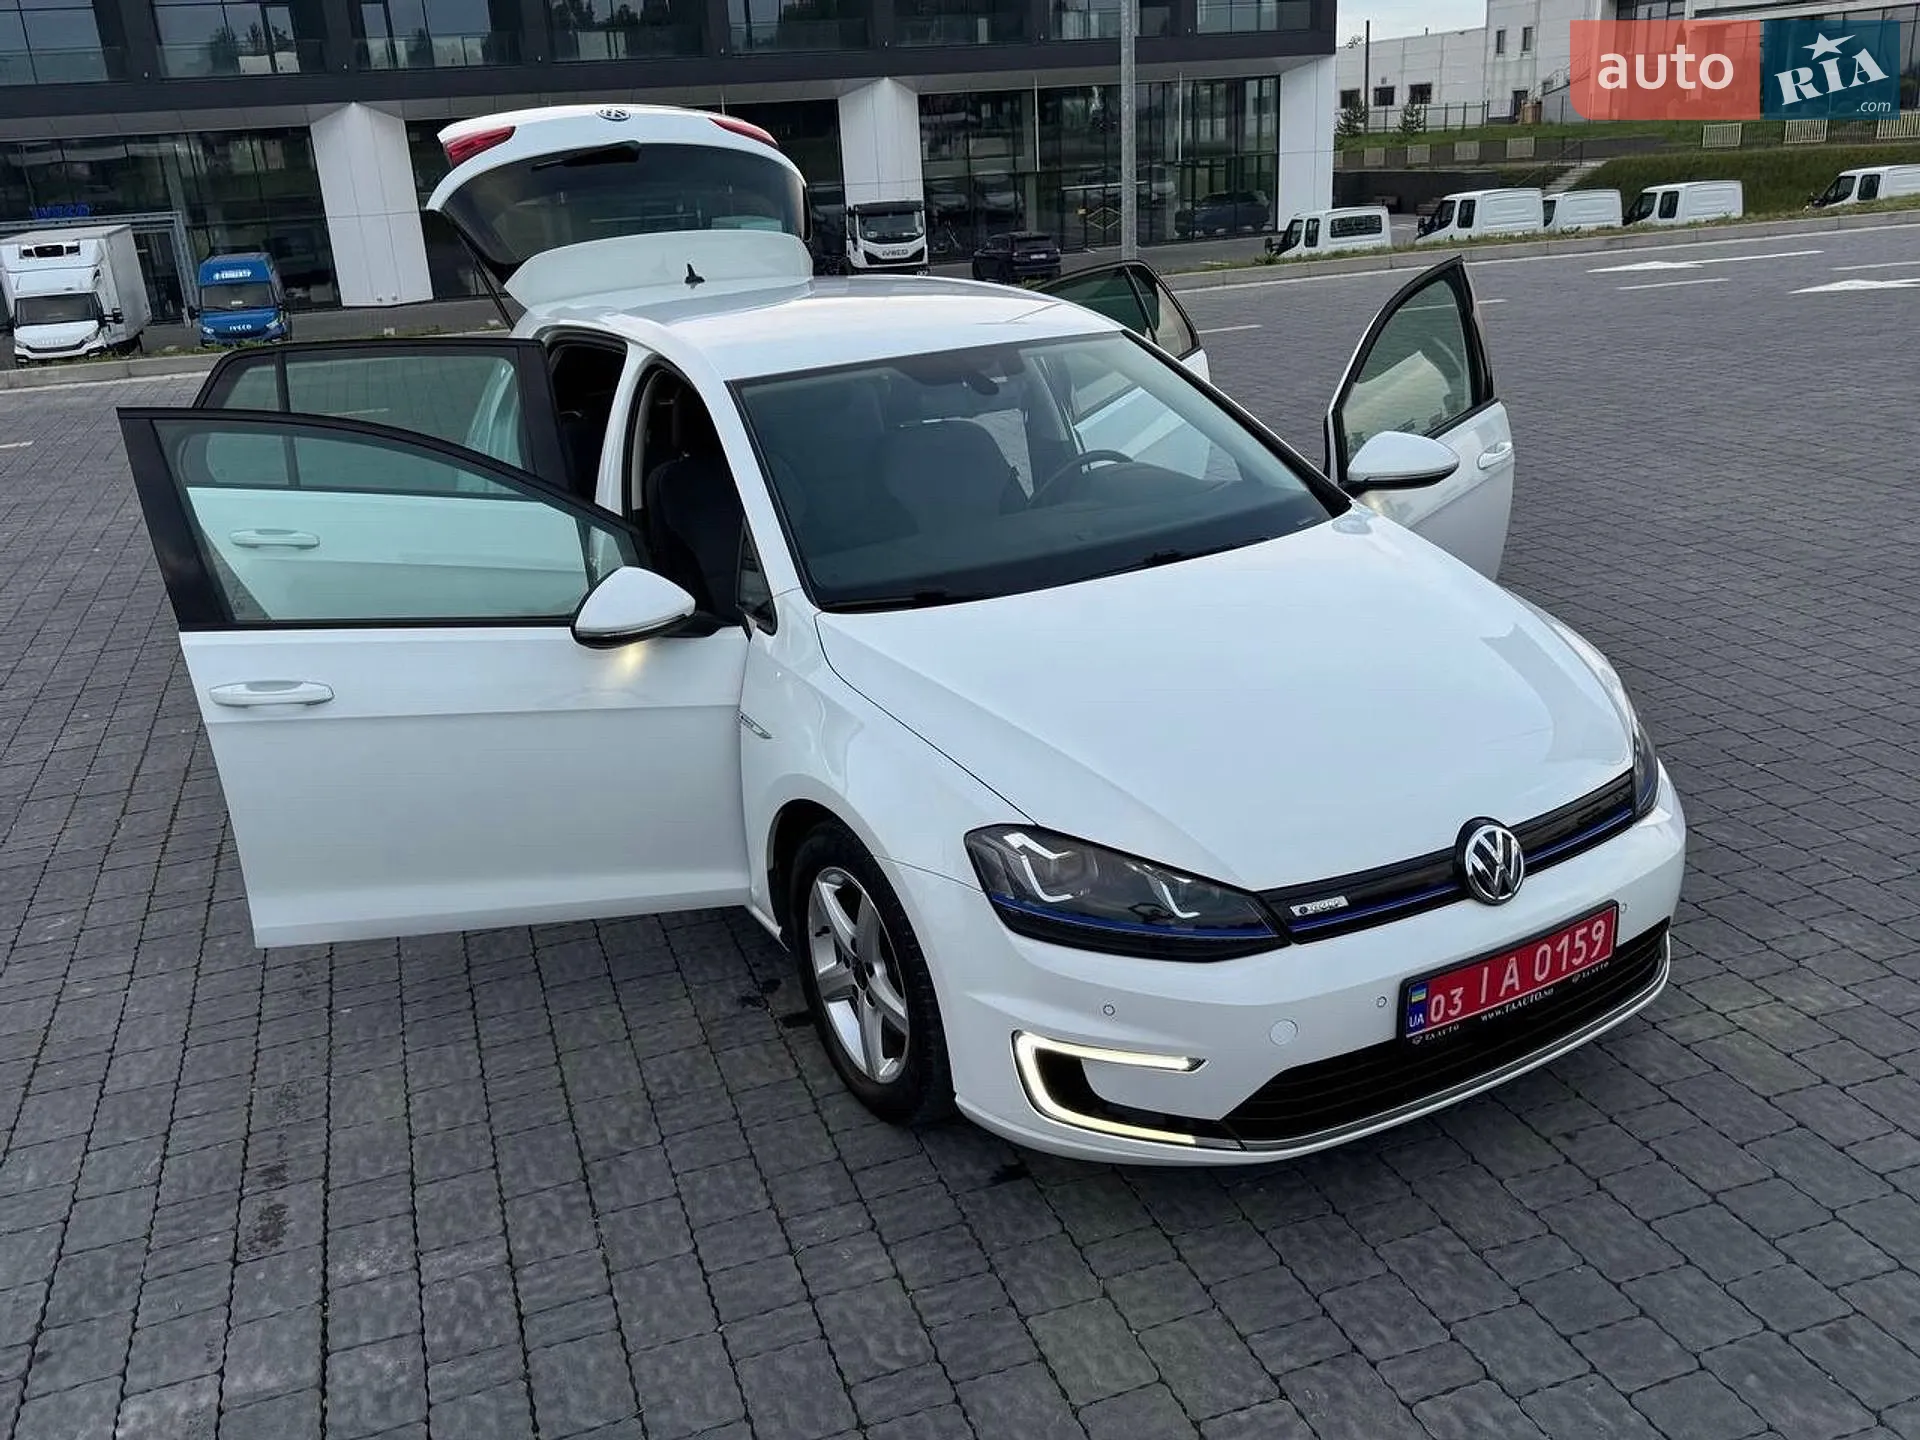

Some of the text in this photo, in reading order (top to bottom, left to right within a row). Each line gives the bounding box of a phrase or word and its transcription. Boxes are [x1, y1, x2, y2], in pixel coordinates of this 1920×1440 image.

[1429, 986, 1464, 1023] 03
[1534, 919, 1606, 983] 0159
[1408, 1013, 1425, 1028] UA
